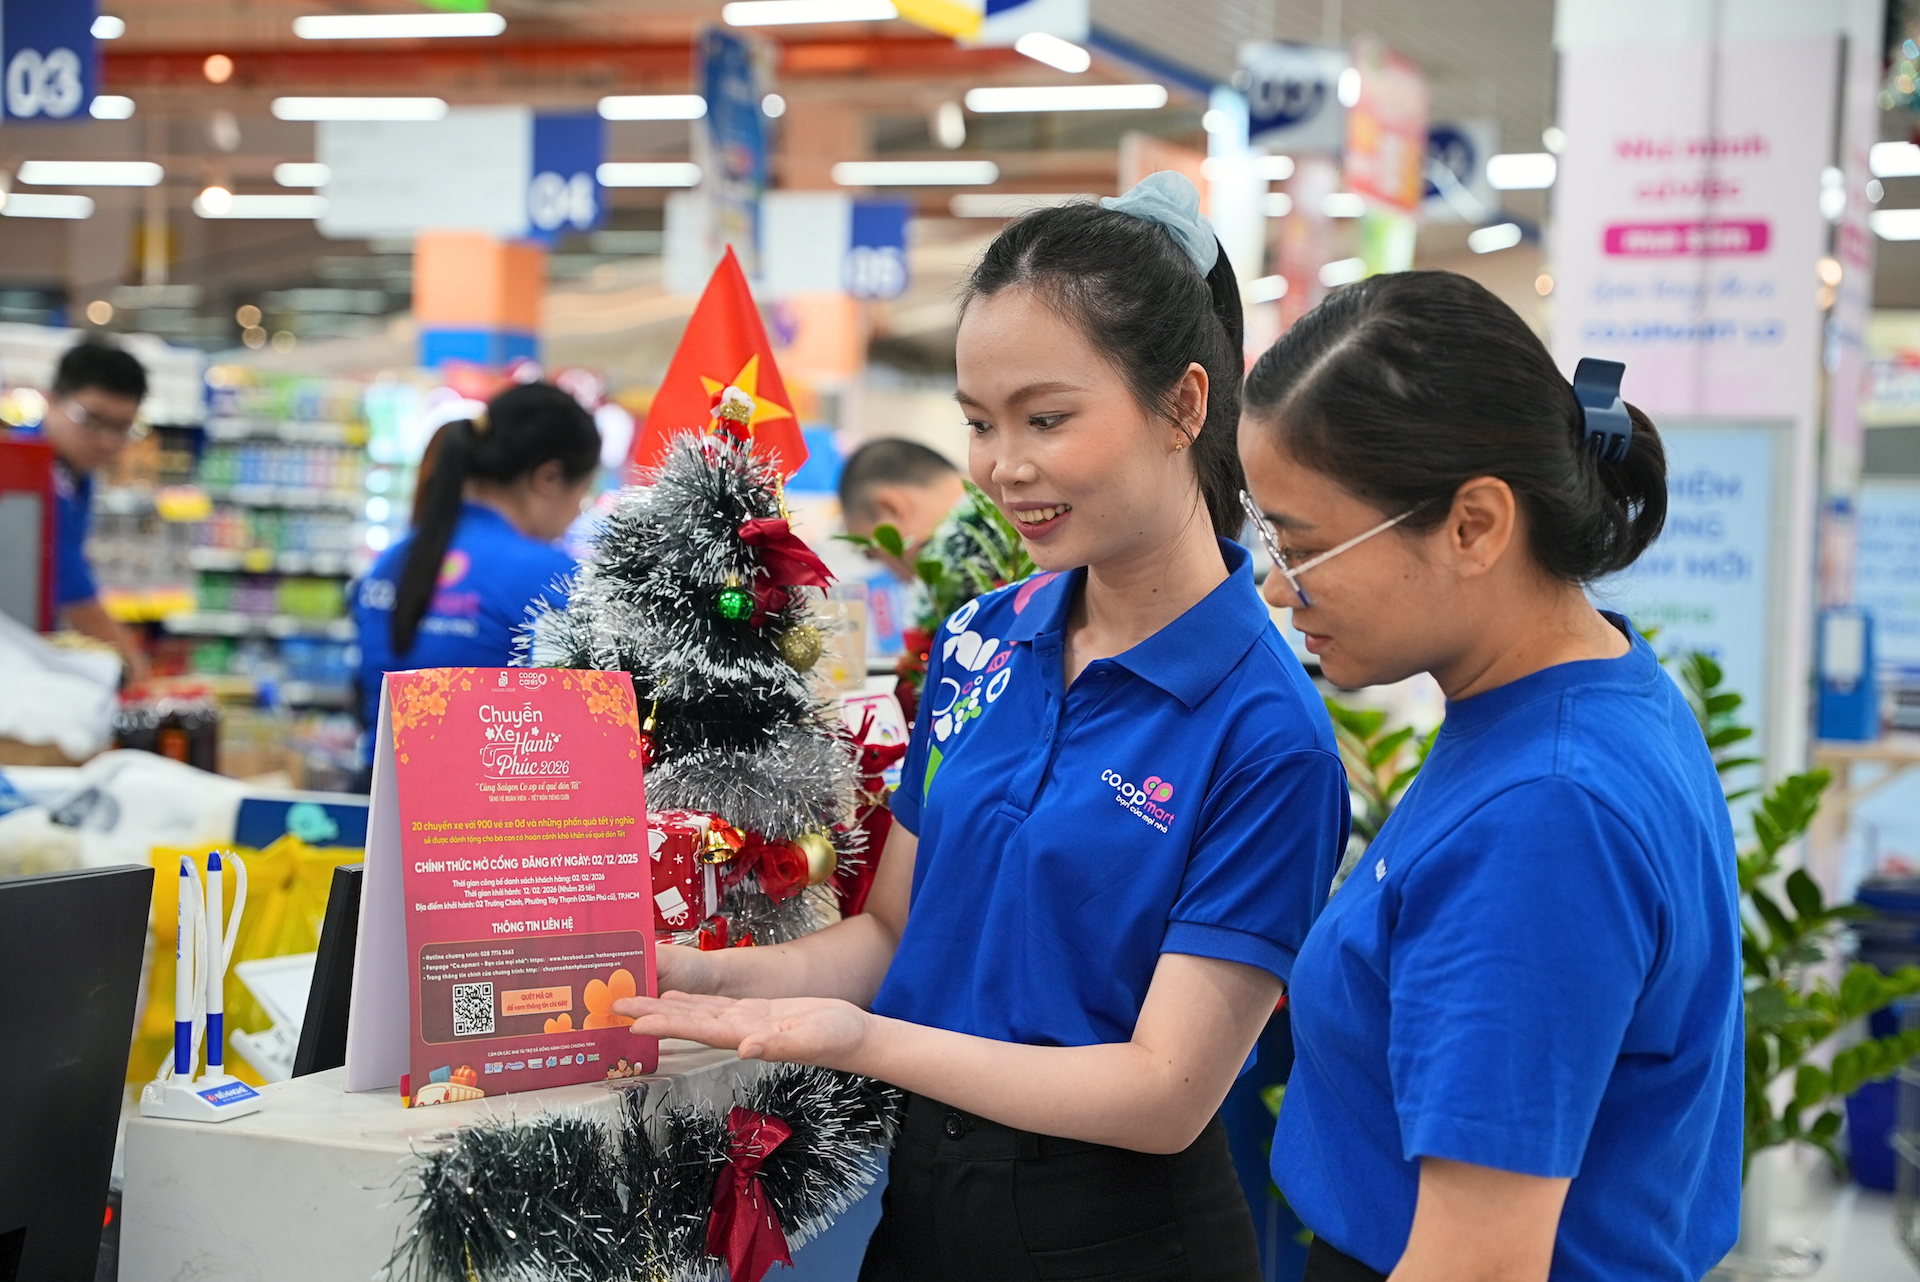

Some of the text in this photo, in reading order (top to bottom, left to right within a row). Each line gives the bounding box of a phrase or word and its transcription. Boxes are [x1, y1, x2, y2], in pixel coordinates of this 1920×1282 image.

[6, 46, 84, 118] 03
[479, 702, 543, 728] Chuyến
[494, 724, 515, 742] Xe
[513, 731, 555, 755] Hạnh
[496, 754, 570, 776] Phúc 2026
[1101, 769, 1147, 805] co.op
[1143, 801, 1175, 826] mart
[412, 821, 422, 830] 20
[423, 820, 452, 832] chuyến
[465, 820, 476, 829] với
[477, 820, 493, 829] 900
[493, 820, 503, 828] vé
[514, 819, 526, 828] 0đ
[526, 818, 536, 827] và
[538, 817, 562, 828] những
[563, 816, 582, 828] phần
[583, 817, 597, 827] quà
[598, 815, 608, 825] tết
[609, 816, 614, 826] ý
[615, 815, 635, 826] nghĩa
[449, 835, 466, 844] dành
[494, 834, 503, 842] bà
[542, 832, 556, 840] cảnh
[557, 832, 570, 840] khó
[593, 831, 604, 840] quê
[605, 830, 616, 838] đón
[616, 829, 626, 838] Tết
[414, 853, 639, 873] CHÍNH THỨC MỞ CỔNG ĐĂNG KÝ NGÀY: 02/12/2025
[452, 879, 466, 887] Thời
[466, 879, 480, 888] gian
[480, 878, 496, 888] công
[496, 877, 504, 886] bố
[520, 876, 535, 884] sách
[535, 875, 553, 883] khách
[554, 874, 571, 884] hàng:
[571, 873, 605, 882] 02/02/2026
[464, 889, 477, 898] Thời
[477, 889, 491, 898] gian
[491, 887, 504, 896] khởi
[504, 887, 521, 896] hành:
[523, 885, 557, 894] 12/02/2026
[577, 884, 585, 892] 25
[415, 903, 426, 912] Địa
[427, 901, 443, 910] điểm
[443, 901, 457, 910] khởi
[458, 900, 475, 909] hành:
[475, 900, 484, 908] 02
[484, 899, 505, 908] Trường
[524, 897, 548, 906] Phường
[548, 896, 558, 904] Tây
[559, 895, 578, 904] Thạnh
[596, 893, 606, 901] Phú
[491, 916, 574, 934] THÔNG TIN LIÊN HỆ
[426, 964, 449, 972] Fanpage
[536, 992, 544, 1000] MÃ
[545, 992, 553, 1000] QR
